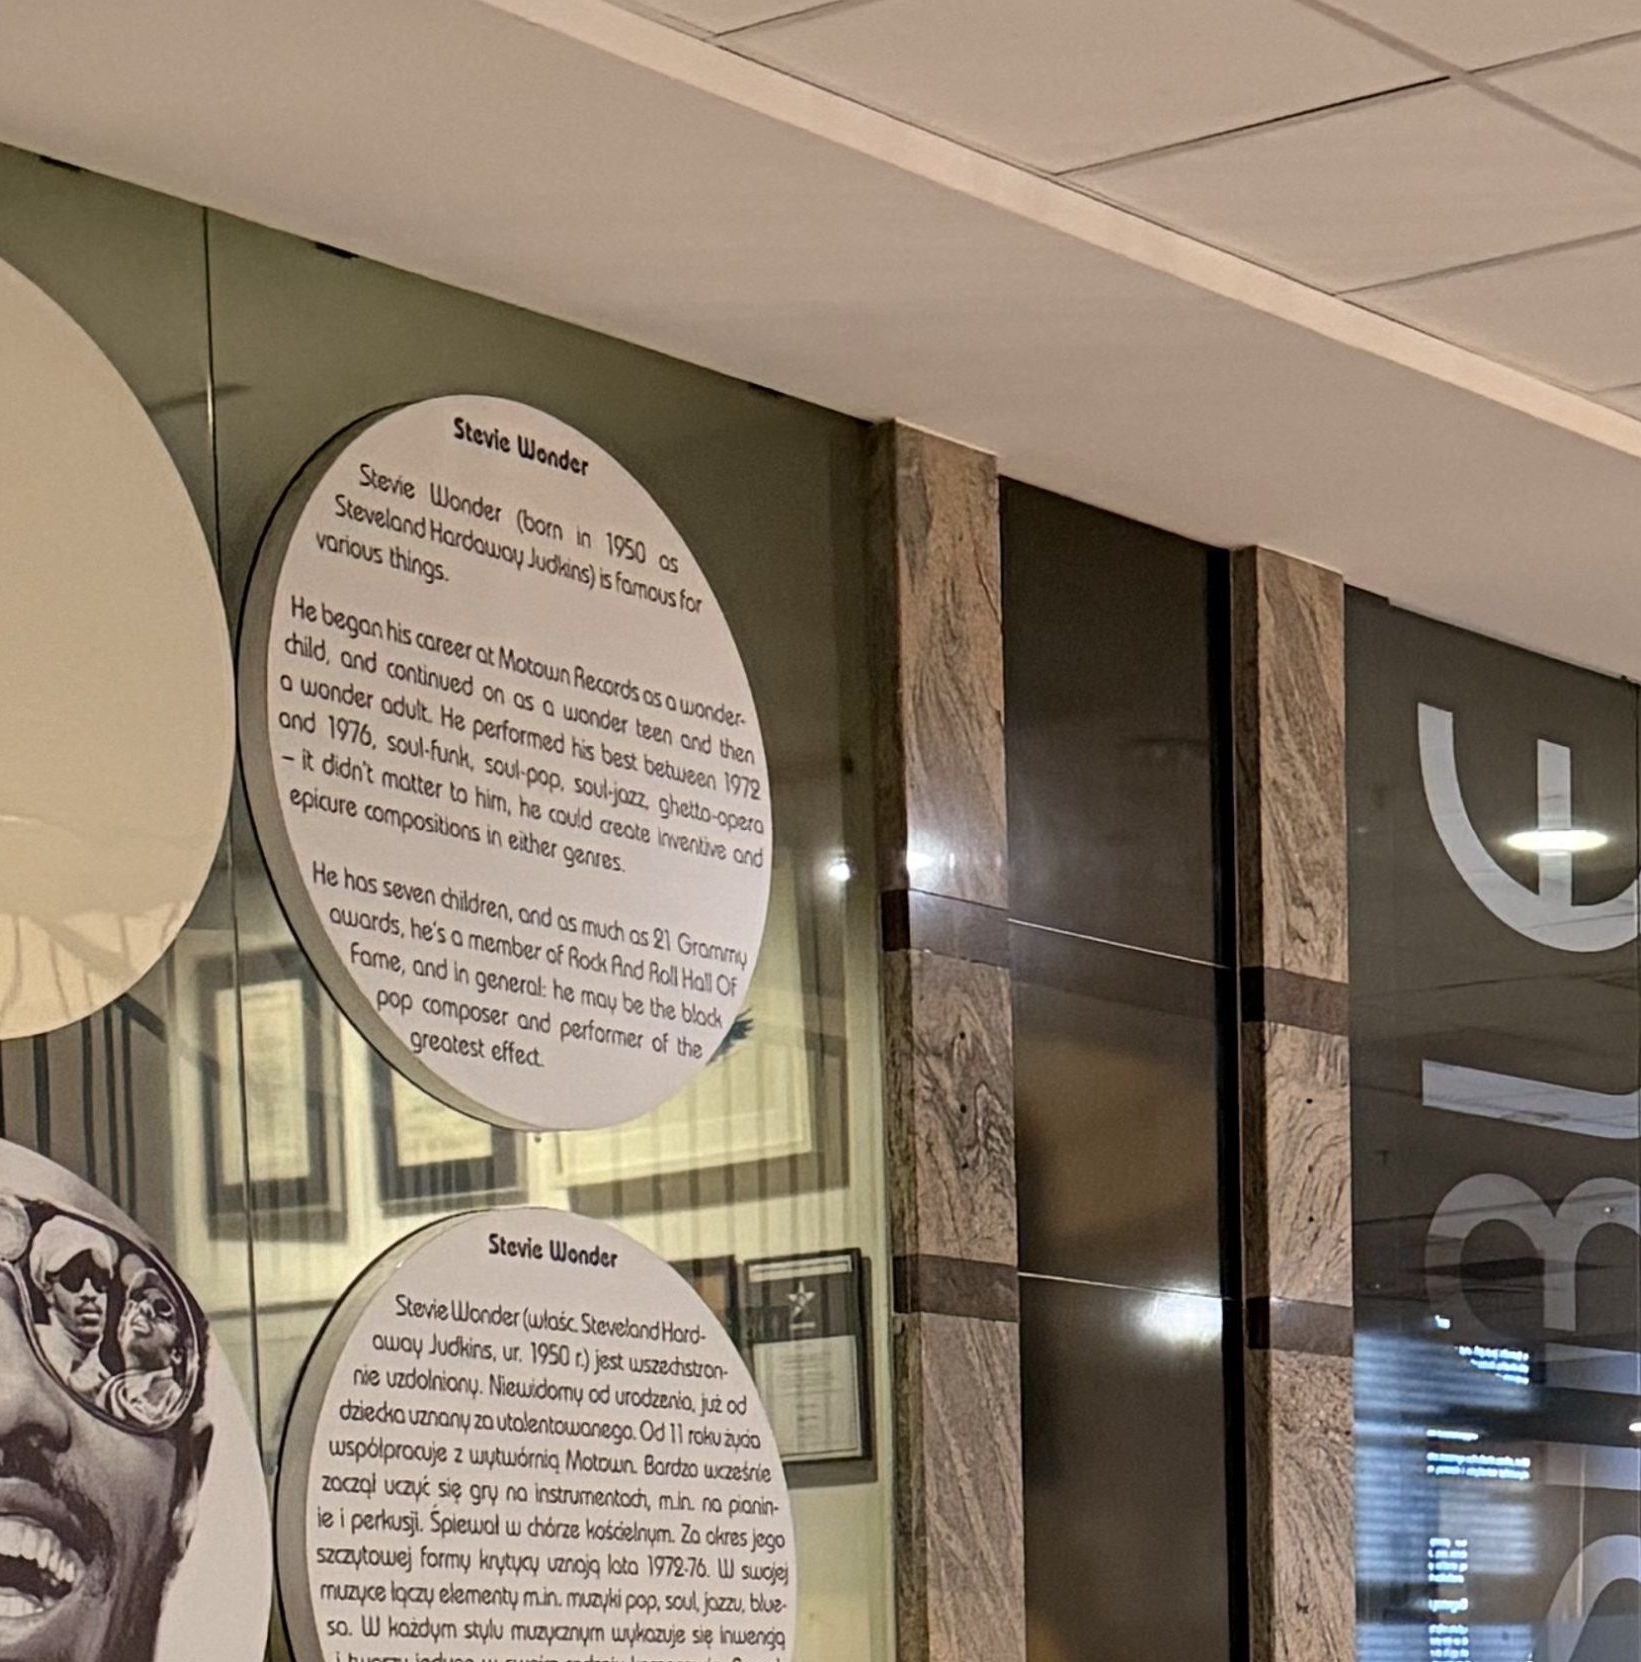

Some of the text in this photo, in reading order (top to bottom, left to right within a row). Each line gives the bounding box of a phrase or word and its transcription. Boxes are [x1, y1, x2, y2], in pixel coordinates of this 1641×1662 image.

[452, 415, 589, 477] Stevie Wonder
[358, 462, 679, 574] Stevie Wonder (born in 1950 as
[314, 531, 450, 585] various things.
[333, 492, 703, 614] Steveland Hardaway Judkins) is famous for
[290, 593, 318, 623] He
[320, 601, 383, 640] began
[385, 617, 412, 646] his
[414, 631, 473, 660] career
[475, 645, 495, 667] at
[497, 644, 571, 686] Motown
[573, 664, 640, 703] Records
[641, 688, 663, 708] as
[664, 694, 677, 712] a
[278, 673, 293, 692] a
[299, 677, 374, 710] wonder
[439, 703, 466, 732] He
[471, 717, 565, 754] performed
[570, 734, 595, 762] his
[599, 741, 638, 772] best
[642, 752, 717, 791] between
[723, 770, 761, 801] 1972
[339, 649, 377, 674] and
[385, 661, 474, 697] continued
[481, 684, 505, 705] on
[512, 691, 535, 712] as
[541, 698, 555, 718] a
[562, 703, 629, 735] wonder
[635, 717, 673, 746] teen
[679, 732, 712, 755] and
[718, 737, 755, 765] then
[277, 710, 316, 734] and
[327, 713, 377, 751] 1976,
[385, 734, 475, 773] soul-funk,
[483, 756, 565, 794] soul-pop,
[657, 792, 764, 835] ghetto-opera
[311, 859, 747, 970] He has seven children, and as much as 21 Grammy
[487, 1231, 619, 1268] Stevie Wonder
[394, 1292, 449, 1321] Stevie
[450, 1298, 521, 1327] Wonder
[580, 1311, 660, 1341] Steveland
[371, 1333, 423, 1360] away
[427, 1331, 497, 1363] Judkins,
[501, 1344, 523, 1363] ur.
[529, 1340, 570, 1367] 1950
[592, 1347, 624, 1376] jest
[352, 1363, 381, 1387] nie
[488, 1372, 584, 1408] Niewidomy
[587, 1383, 611, 1405] od
[697, 1391, 723, 1418] już
[725, 1394, 747, 1416] od
[316, 1504, 335, 1529] ie
[339, 1506, 345, 1528] i
[350, 1507, 424, 1538] perkusji.
[504, 1519, 522, 1537] w
[525, 1514, 580, 1540] chórze
[679, 1521, 701, 1545] Za
[704, 1524, 748, 1547] okres
[749, 1527, 786, 1555] jego
[419, 1544, 471, 1575] formy
[546, 1552, 601, 1580] uznają
[606, 1552, 639, 1576] lata
[716, 1556, 735, 1580] W
[740, 1561, 789, 1587] swojej
